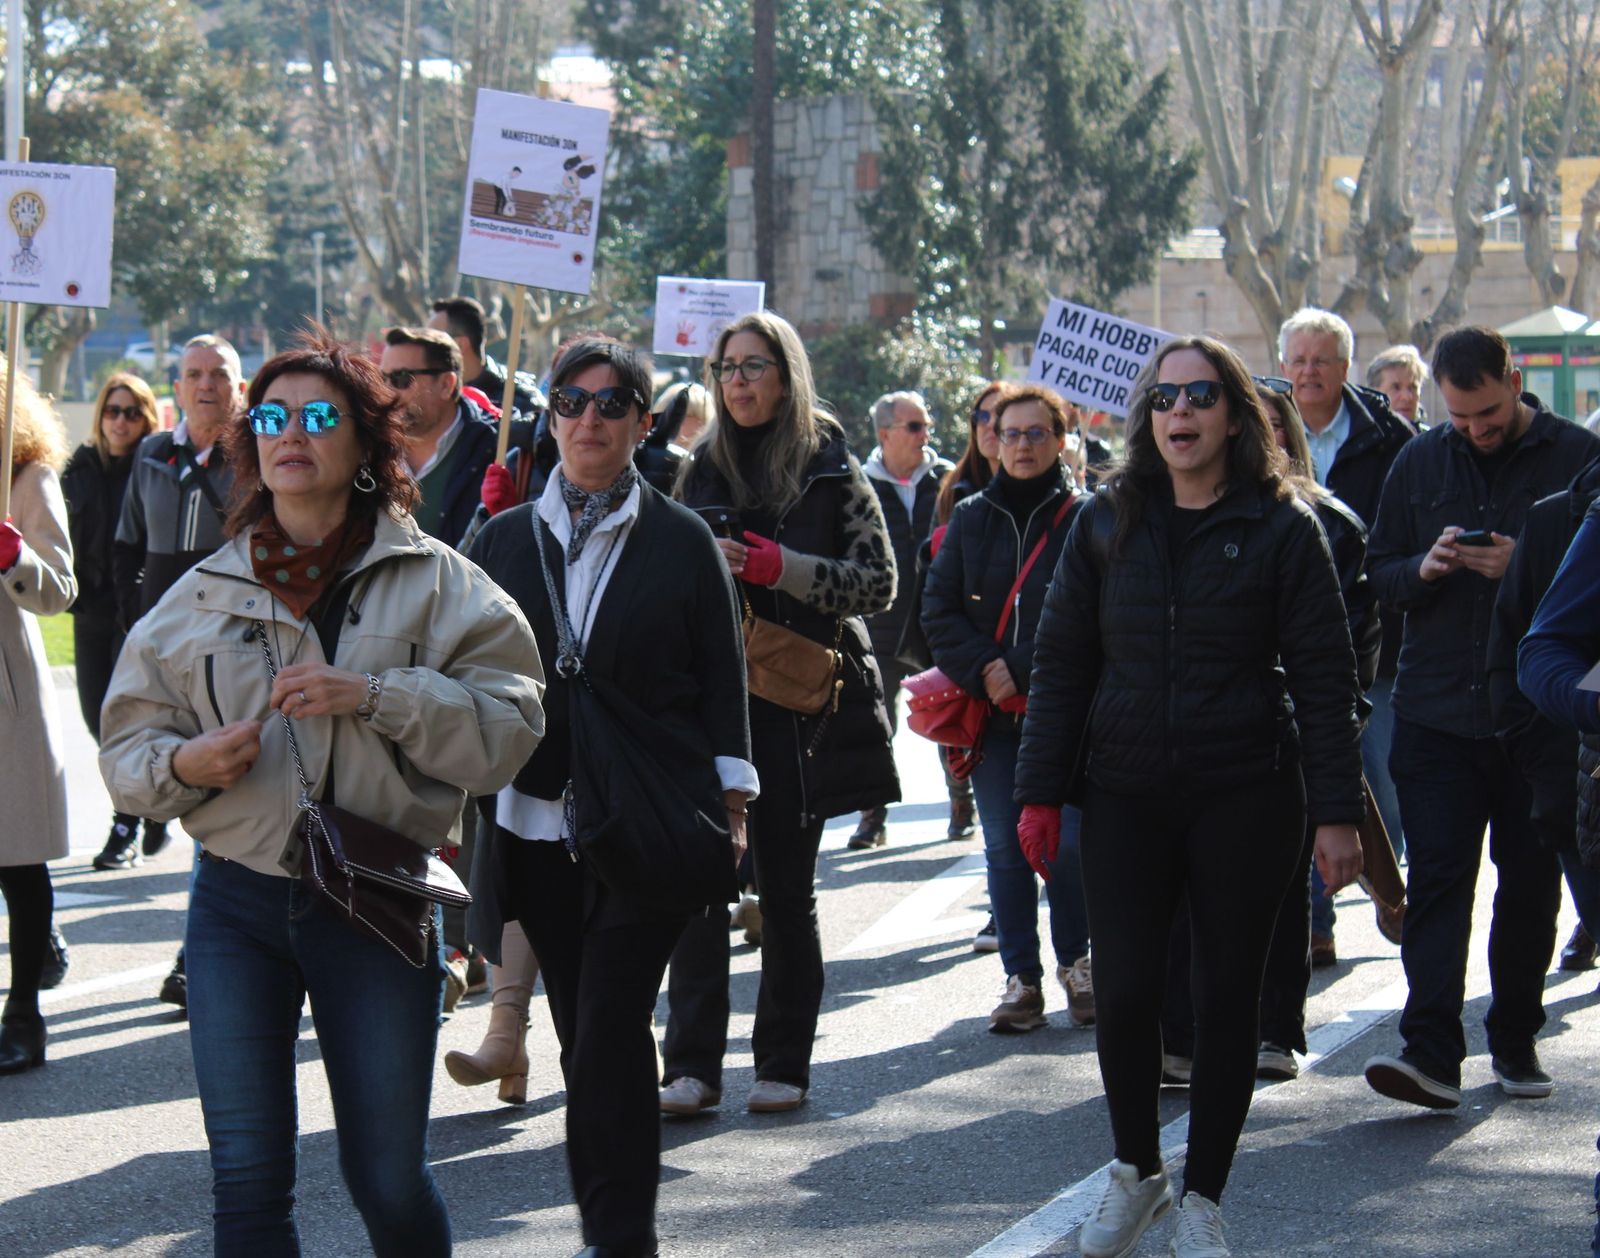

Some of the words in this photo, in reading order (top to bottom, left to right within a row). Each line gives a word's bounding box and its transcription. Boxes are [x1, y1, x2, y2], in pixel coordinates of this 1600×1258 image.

[501, 128, 560, 148] MANIFESTACIÓN
[469, 218, 523, 236] Sembrando
[525, 228, 554, 241] futuro
[1057, 307, 1087, 334] MI
[1038, 332, 1099, 368] PAGAR
[1102, 354, 1141, 381] CUO
[1040, 360, 1053, 380] Y
[1055, 367, 1129, 408] FACTUR
